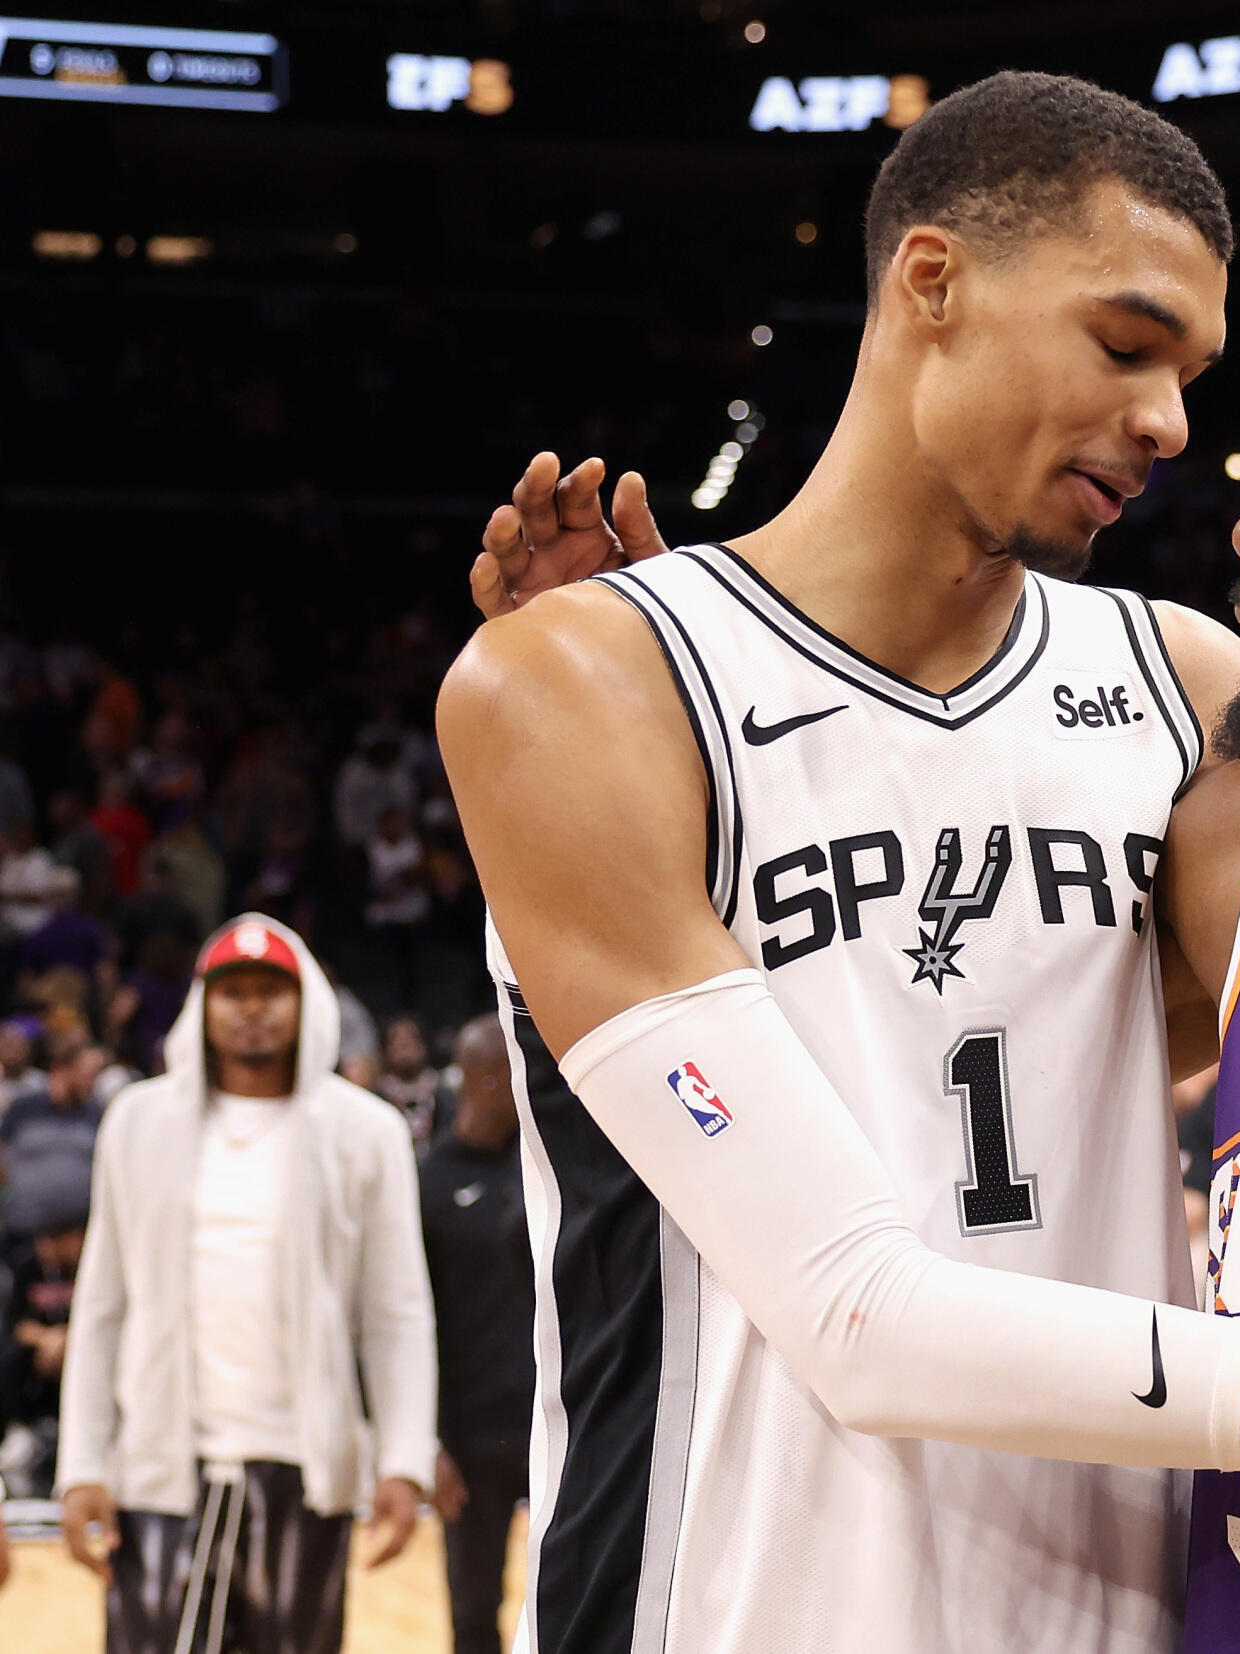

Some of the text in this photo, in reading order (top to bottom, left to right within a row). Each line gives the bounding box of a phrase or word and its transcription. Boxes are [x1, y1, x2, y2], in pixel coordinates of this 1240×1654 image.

[1053, 684, 1144, 728] Self.
[703, 1115, 726, 1135] NBA
[943, 1027, 1043, 1238] 1
